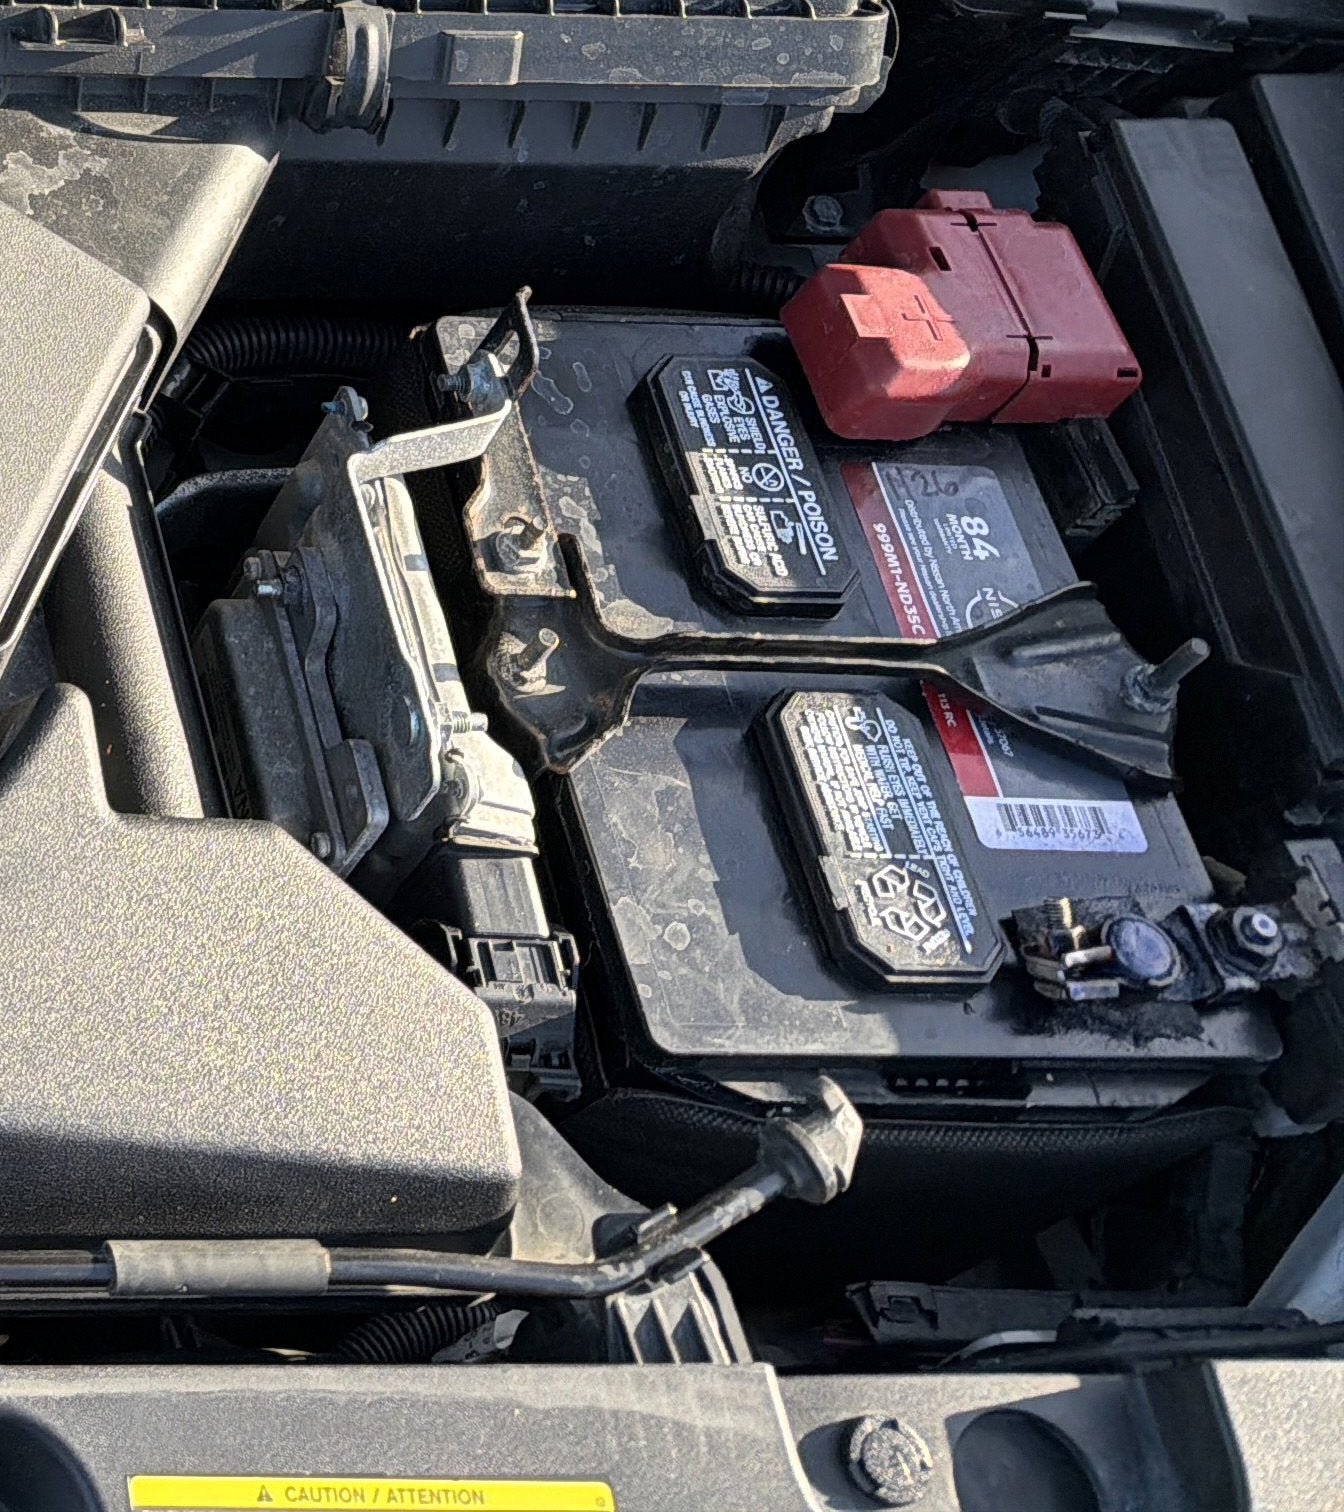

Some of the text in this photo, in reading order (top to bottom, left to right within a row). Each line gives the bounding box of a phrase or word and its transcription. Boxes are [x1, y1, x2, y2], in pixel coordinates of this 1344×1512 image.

[700, 394, 720, 422] GASES
[712, 395, 740, 442] EXPLOSIVE
[733, 417, 749, 439] EYES
[744, 417, 765, 448] SHIELD
[738, 467, 752, 482] NO
[761, 396, 803, 469] DANGER
[797, 490, 838, 559] POISON
[752, 505, 788, 575] SULFURIC ACID
[946, 514, 973, 559] MONTH
[959, 516, 1000, 560] 84
[904, 500, 956, 614] Distributed by Nissan North
[872, 523, 925, 634] 999M1-ND35C
[885, 720, 897, 732] DO
[943, 712, 956, 726] RC
[890, 735, 905, 753] NOT
[852, 744, 894, 830] MEDICAL HELP FAST
[864, 745, 881, 766] WITH
[886, 802, 901, 818] GET
[906, 776, 921, 798] KEEP
[877, 745, 927, 853] FLUSH EYES IMMEDIATELY
[915, 801, 931, 825] VENT
[902, 739, 976, 915] KEEP OUT OF THE REACH OF CHILDREN
[926, 827, 941, 851] CAPS
[936, 855, 953, 881] TIGHT
[948, 885, 961, 903] AND
[284, 1485, 366, 1503] CAUTION
[386, 1488, 485, 1505] ATTENTION
